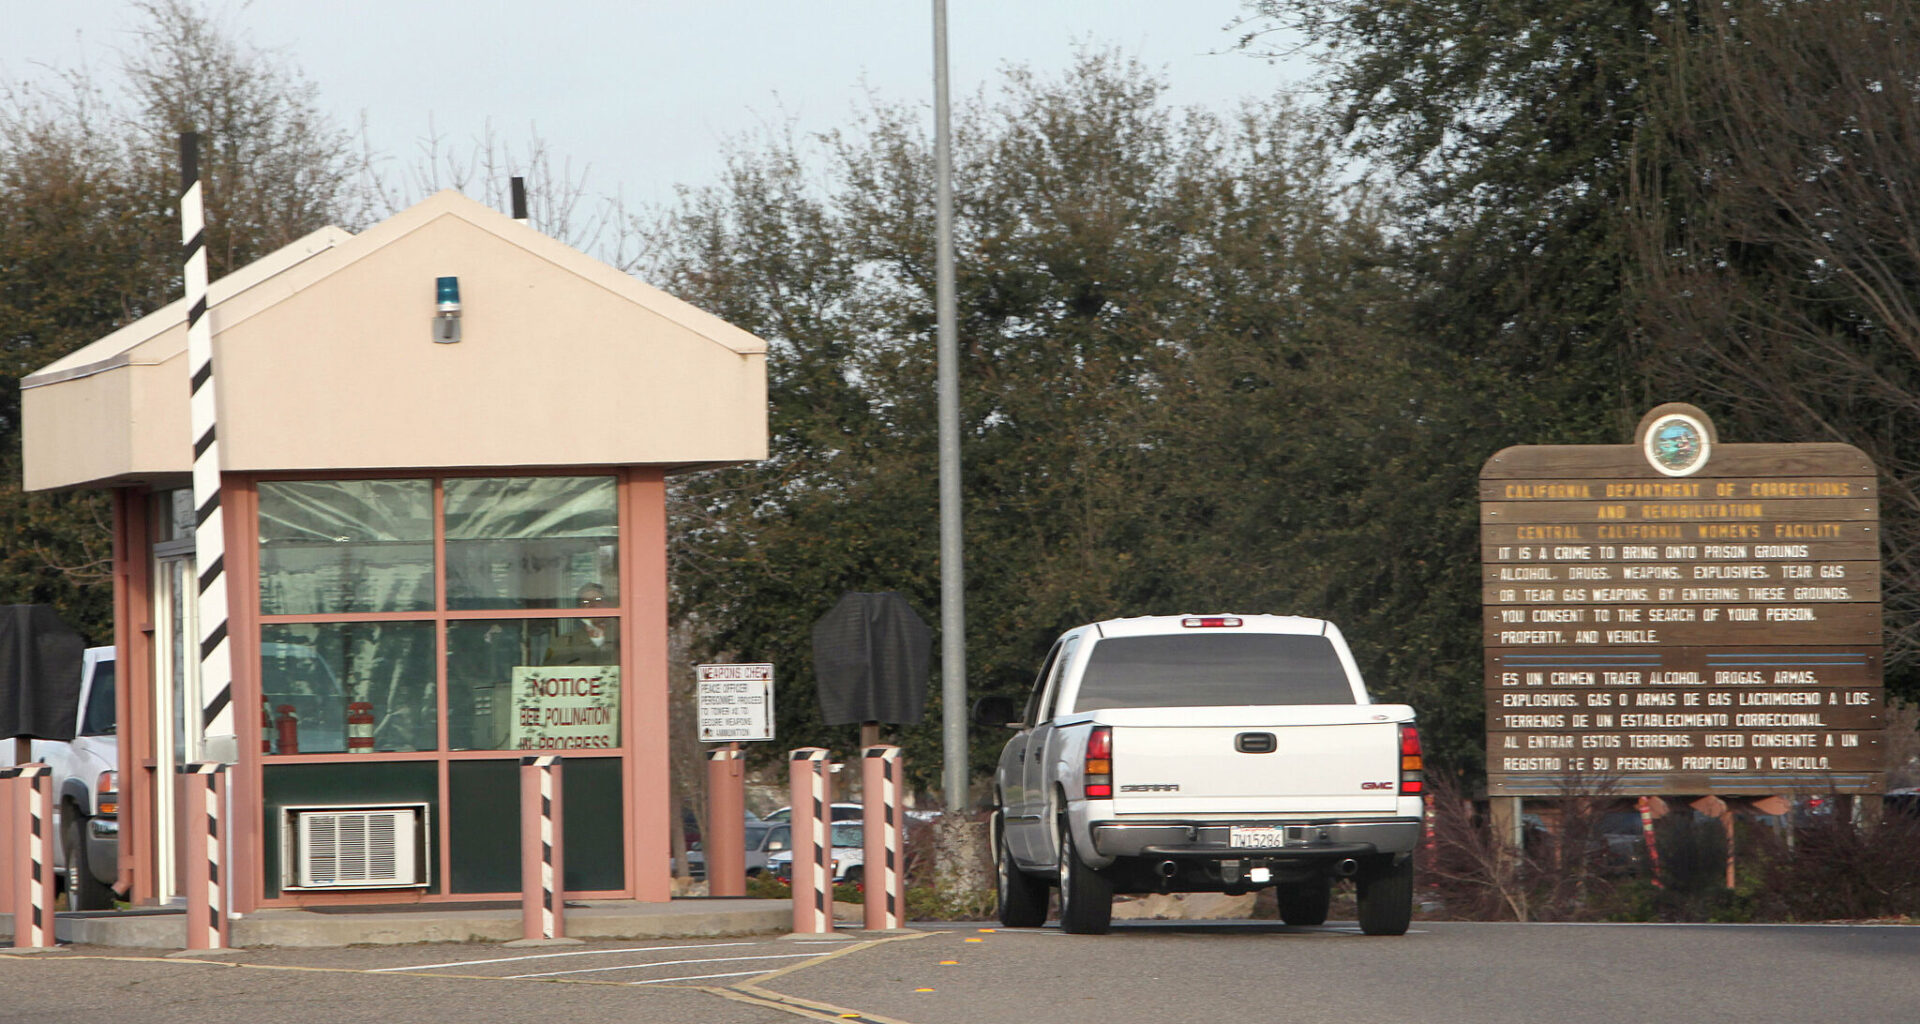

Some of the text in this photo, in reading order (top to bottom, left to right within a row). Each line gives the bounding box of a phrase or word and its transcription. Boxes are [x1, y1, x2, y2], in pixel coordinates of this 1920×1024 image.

[1505, 482, 1849, 498] CALIFORNIA DEPARTMENT OF CORRECTIONS
[1598, 504, 1763, 519] AND REHABILITATION
[1517, 524, 1840, 540] CENTRAL CALIFORNIA WOMEN'S FACILITY
[1499, 545, 1809, 560] IT IS A CRIME TO BRING ONTO PRISON GROUNDS
[1781, 565, 1813, 579] TEAR
[1820, 565, 1845, 578] GAS
[1500, 589, 1516, 602] OR
[1524, 589, 1555, 601] TEAR
[1563, 588, 1587, 601] GAS
[1658, 588, 1675, 601] BY
[1682, 588, 1740, 601] ENTERING
[1747, 587, 1786, 600] THESE
[1501, 609, 1525, 623] YOU
[1532, 609, 1585, 622] CONSENT
[1593, 609, 1611, 622] TO
[1617, 609, 1642, 622] THE
[1649, 608, 1696, 622] SEARCH
[1703, 608, 1720, 621] OF
[1727, 608, 1759, 621] YOUR
[1575, 630, 1599, 643] AND
[702, 667, 741, 678] WEAPONS
[1502, 672, 1519, 686] ES
[1526, 672, 1543, 686] UN
[1550, 672, 1595, 685] CRIMEN
[1603, 672, 1641, 685] TRAER
[531, 678, 601, 697] NOTICE
[1587, 693, 1612, 707] GAS
[1619, 693, 1628, 706] O
[1636, 693, 1676, 706] ARMAS
[1683, 692, 1700, 706] DE
[1707, 692, 1732, 706] GAS
[1739, 692, 1821, 705] LACRIMOGENO
[1828, 692, 1838, 705] A
[1845, 692, 1870, 705] LOS
[520, 707, 610, 726] BEE POLLINATION
[1503, 714, 1565, 728] TERRENOS
[1572, 714, 1589, 727] DE
[1596, 714, 1613, 727] UN
[1620, 713, 1729, 727] ESTABLECIMIENTO
[540, 735, 609, 749] PROGRESS
[1504, 735, 1520, 749] AL
[1528, 735, 1574, 748] ENTRAR
[1582, 735, 1621, 748] ESTOS
[1705, 734, 1745, 748] USTED
[1751, 734, 1817, 747] CONSIENTE
[1825, 734, 1834, 747] A
[1841, 734, 1858, 747] UN
[1504, 757, 1561, 771] REGISTRO
[1593, 757, 1610, 770] SU
[1682, 757, 1747, 770] PROPIEDAD
[1754, 757, 1763, 770] Y
[1120, 784, 1179, 792] SIERRA
[1361, 782, 1393, 790] GMC
